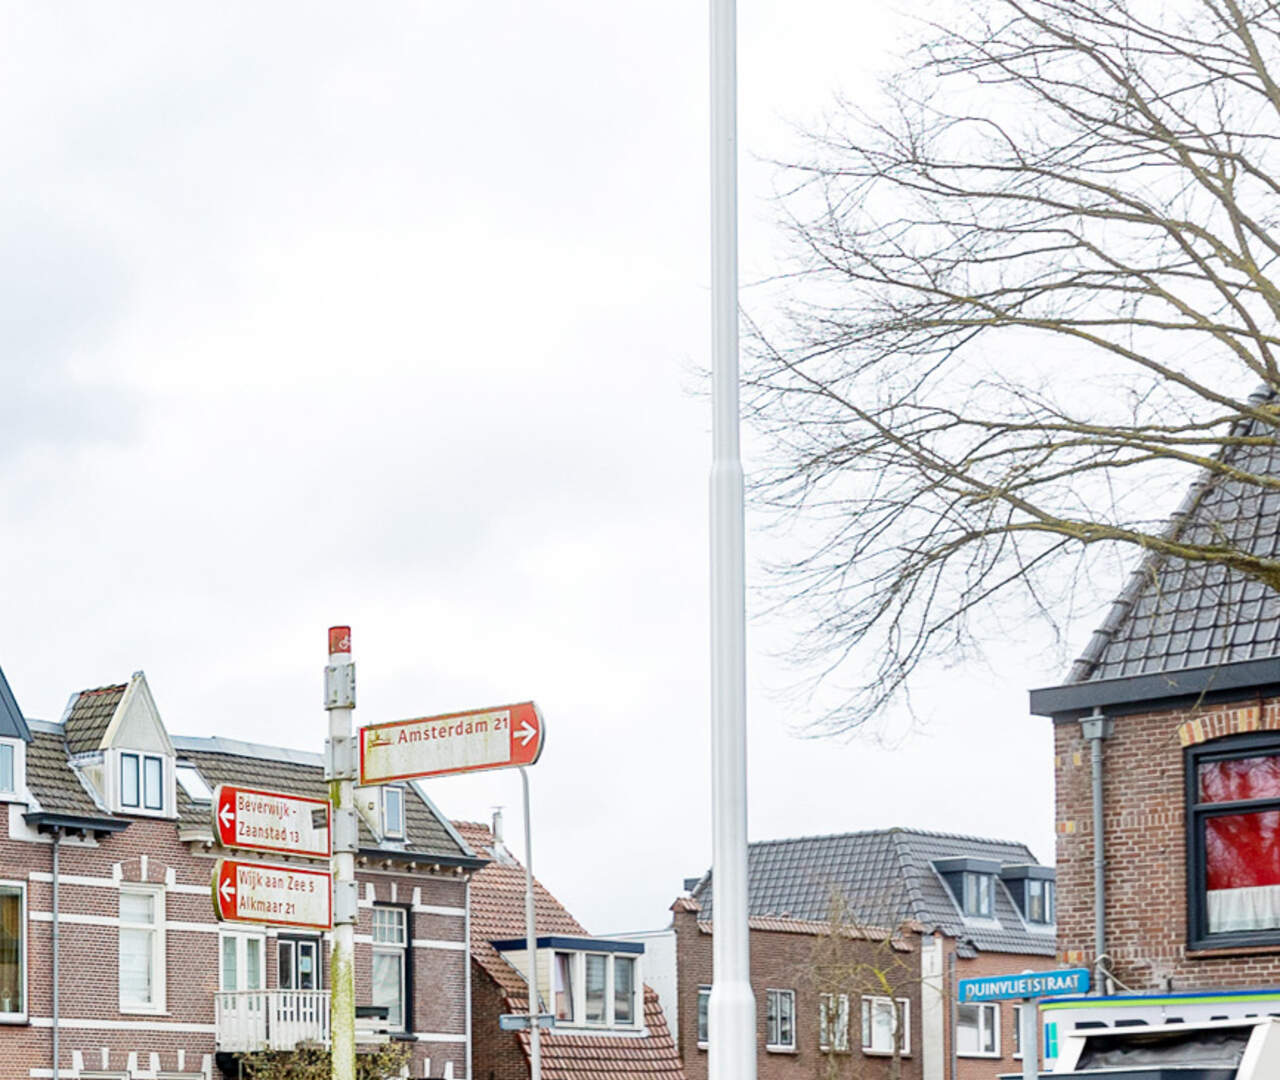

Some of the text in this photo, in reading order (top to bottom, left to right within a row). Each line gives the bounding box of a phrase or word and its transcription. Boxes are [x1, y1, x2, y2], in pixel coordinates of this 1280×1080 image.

[398, 718, 508, 744] Amsterdam 21
[238, 796, 289, 820] Beverwijk
[239, 821, 300, 843] Zaanstad 13
[239, 870, 315, 893] Wijk aan Zee 5
[239, 895, 296, 915] Alkmaar 21
[966, 974, 1080, 997] DUINVLIETSTRAAT
